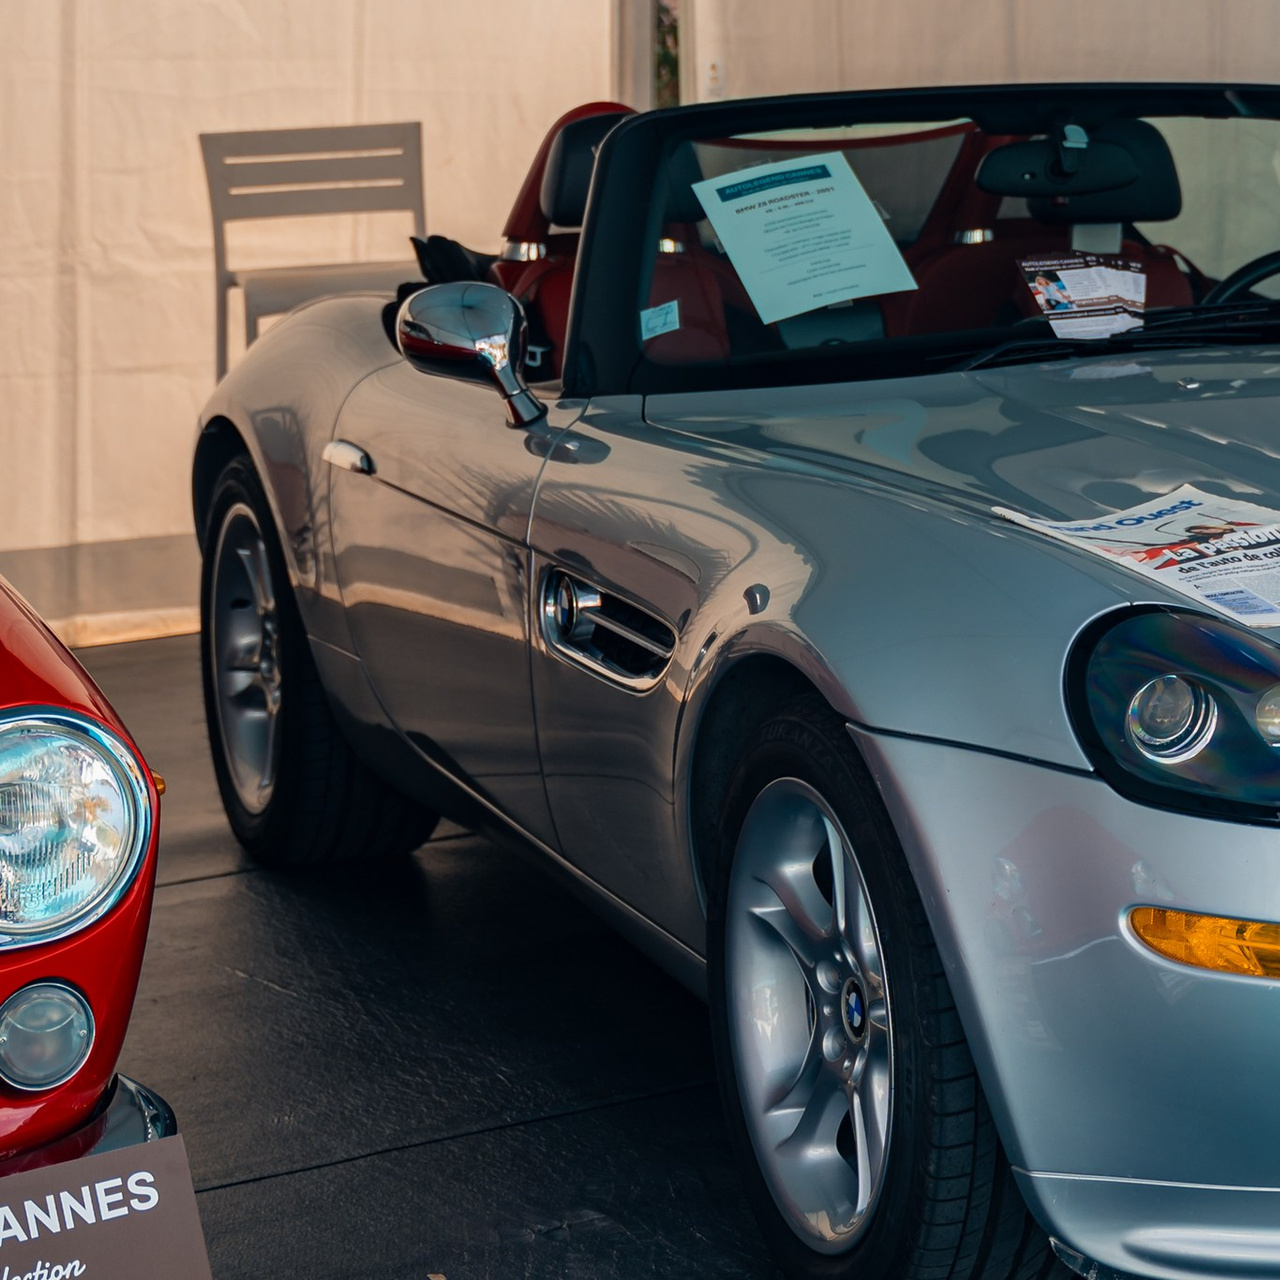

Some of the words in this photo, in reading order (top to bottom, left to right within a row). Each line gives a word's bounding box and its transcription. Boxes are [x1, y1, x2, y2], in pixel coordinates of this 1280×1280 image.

[735, 204, 756, 214] BMW
[768, 191, 810, 205] ROADSTER
[1115, 499, 1204, 527] Ouest
[1178, 565, 1198, 574] de
[1198, 556, 1242, 570] l'auto
[1243, 552, 1260, 561] de
